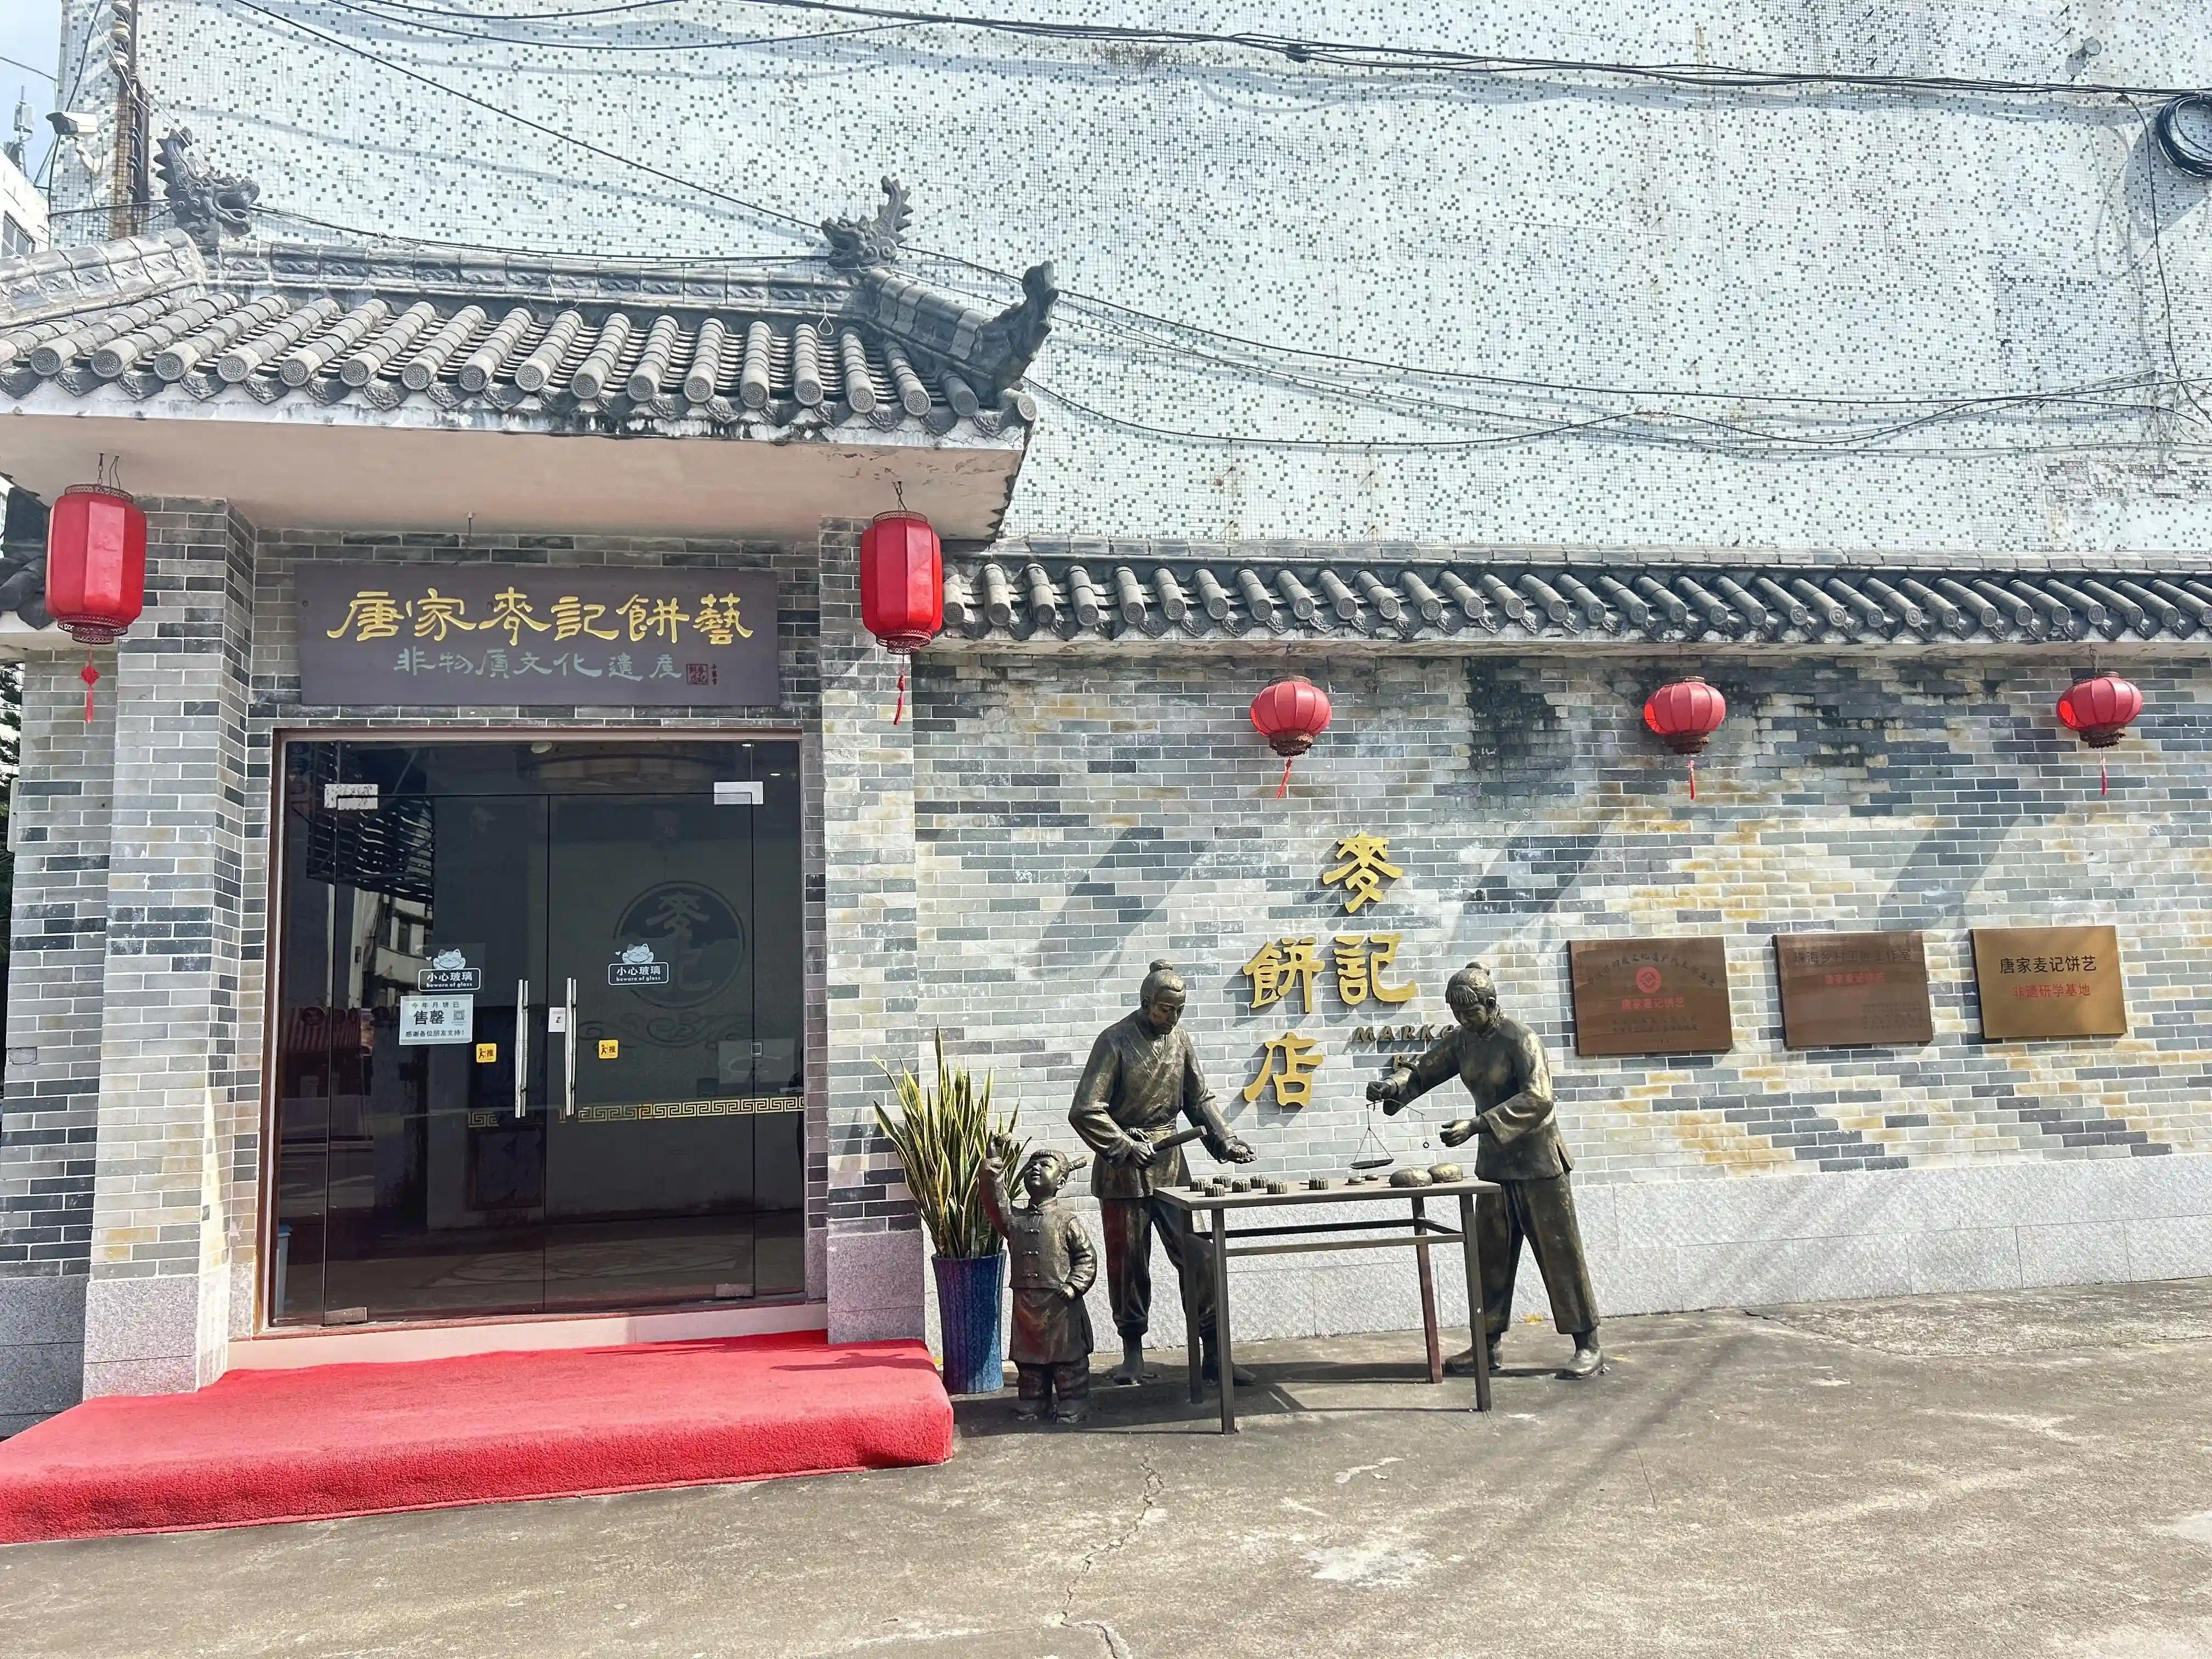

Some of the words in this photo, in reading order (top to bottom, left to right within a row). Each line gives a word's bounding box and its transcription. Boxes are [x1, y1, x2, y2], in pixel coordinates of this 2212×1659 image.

[617, 966, 661, 976] 小心玻璃
[2000, 955, 2097, 974] 唐家麦记饼艺
[427, 971, 472, 982] 小心玻璃
[2013, 983, 2091, 1000] 非遗研学基地
[413, 1010, 445, 1025] 售罄
